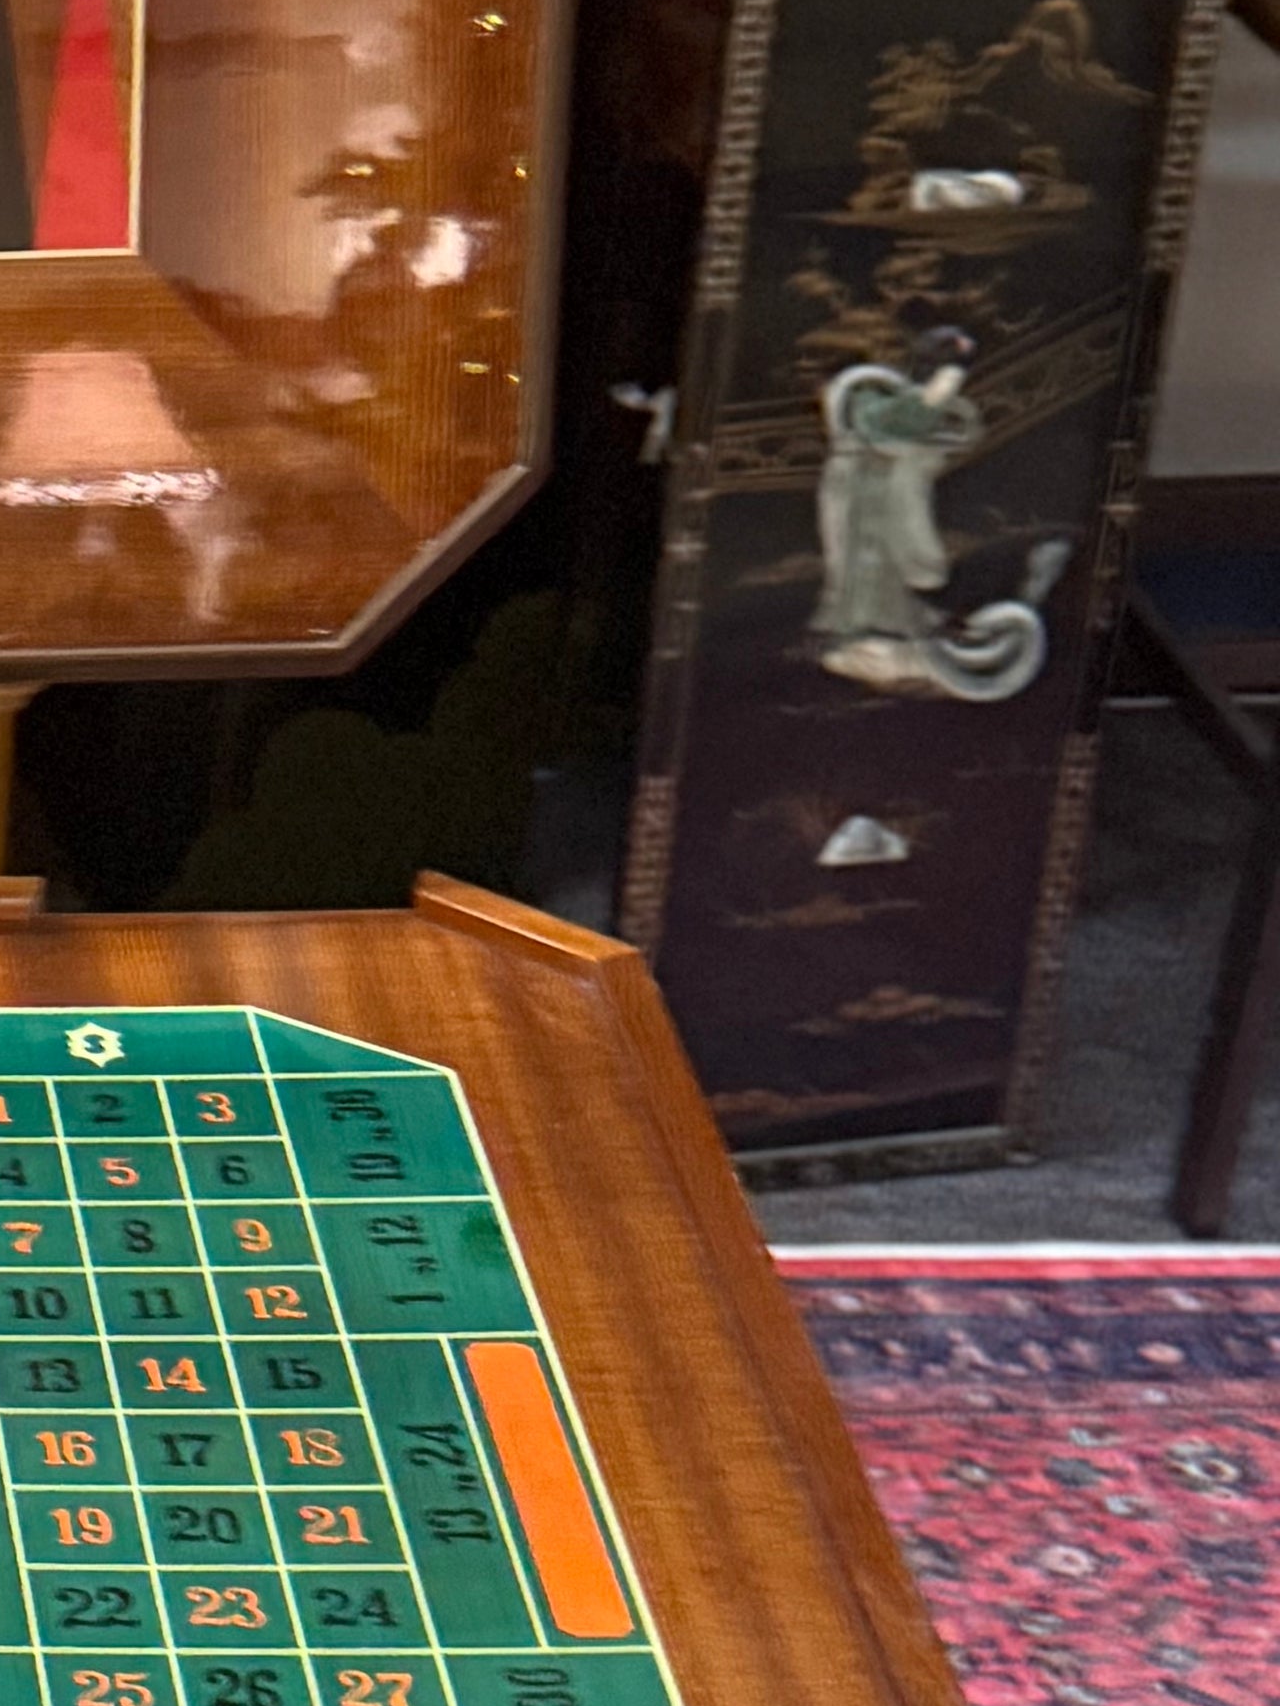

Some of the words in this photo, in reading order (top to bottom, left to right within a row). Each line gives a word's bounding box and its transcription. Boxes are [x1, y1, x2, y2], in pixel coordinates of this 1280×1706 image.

[91, 1093, 127, 1125] 2
[198, 1093, 235, 1124] 3
[101, 1158, 139, 1187] 5
[217, 1154, 250, 1186] 6
[4, 1222, 42, 1255] 7
[122, 1219, 156, 1254] 8
[234, 1219, 271, 1253] 9
[6, 1286, 69, 1321] 10
[129, 1287, 184, 1320] 11
[245, 1285, 307, 1321] 12
[25, 1357, 82, 1394] 13
[139, 1357, 206, 1394] 14
[265, 1357, 323, 1392] 15
[36, 1431, 96, 1468] 16
[157, 1432, 215, 1467] 17
[280, 1429, 343, 1467] 18
[52, 1507, 114, 1547] 19
[164, 1504, 242, 1545] 20
[298, 1505, 366, 1546] 21
[54, 1586, 142, 1629] 22
[186, 1587, 267, 1629] 23
[312, 1587, 399, 1628] 24
